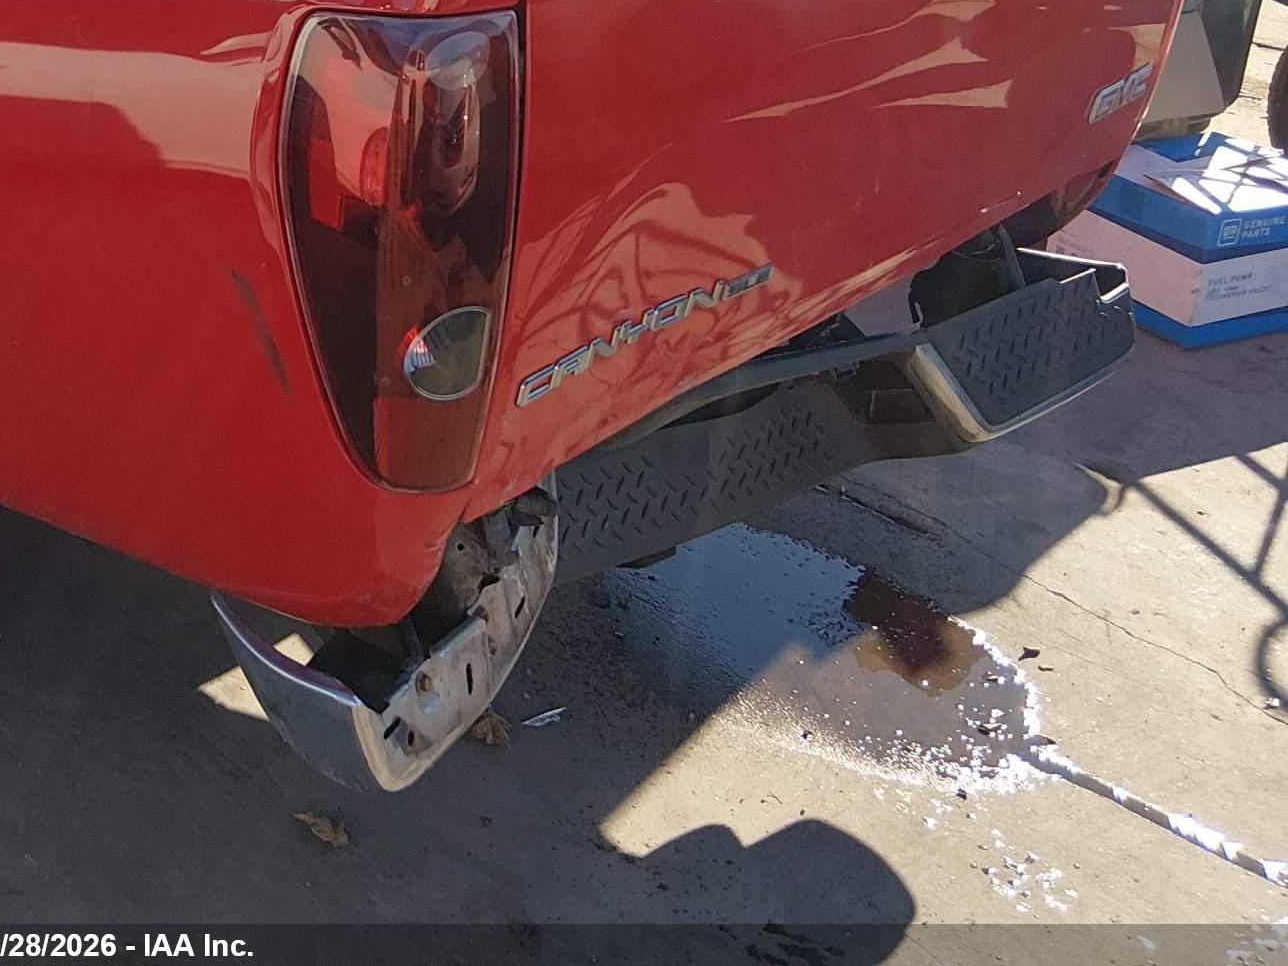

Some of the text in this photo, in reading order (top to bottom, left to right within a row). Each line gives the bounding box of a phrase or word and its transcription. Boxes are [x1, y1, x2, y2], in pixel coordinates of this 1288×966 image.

[1087, 62, 1153, 124] GMC
[1241, 226, 1271, 239] PARTS
[1244, 215, 1287, 230] GENUINE
[515, 280, 725, 408] CANYON
